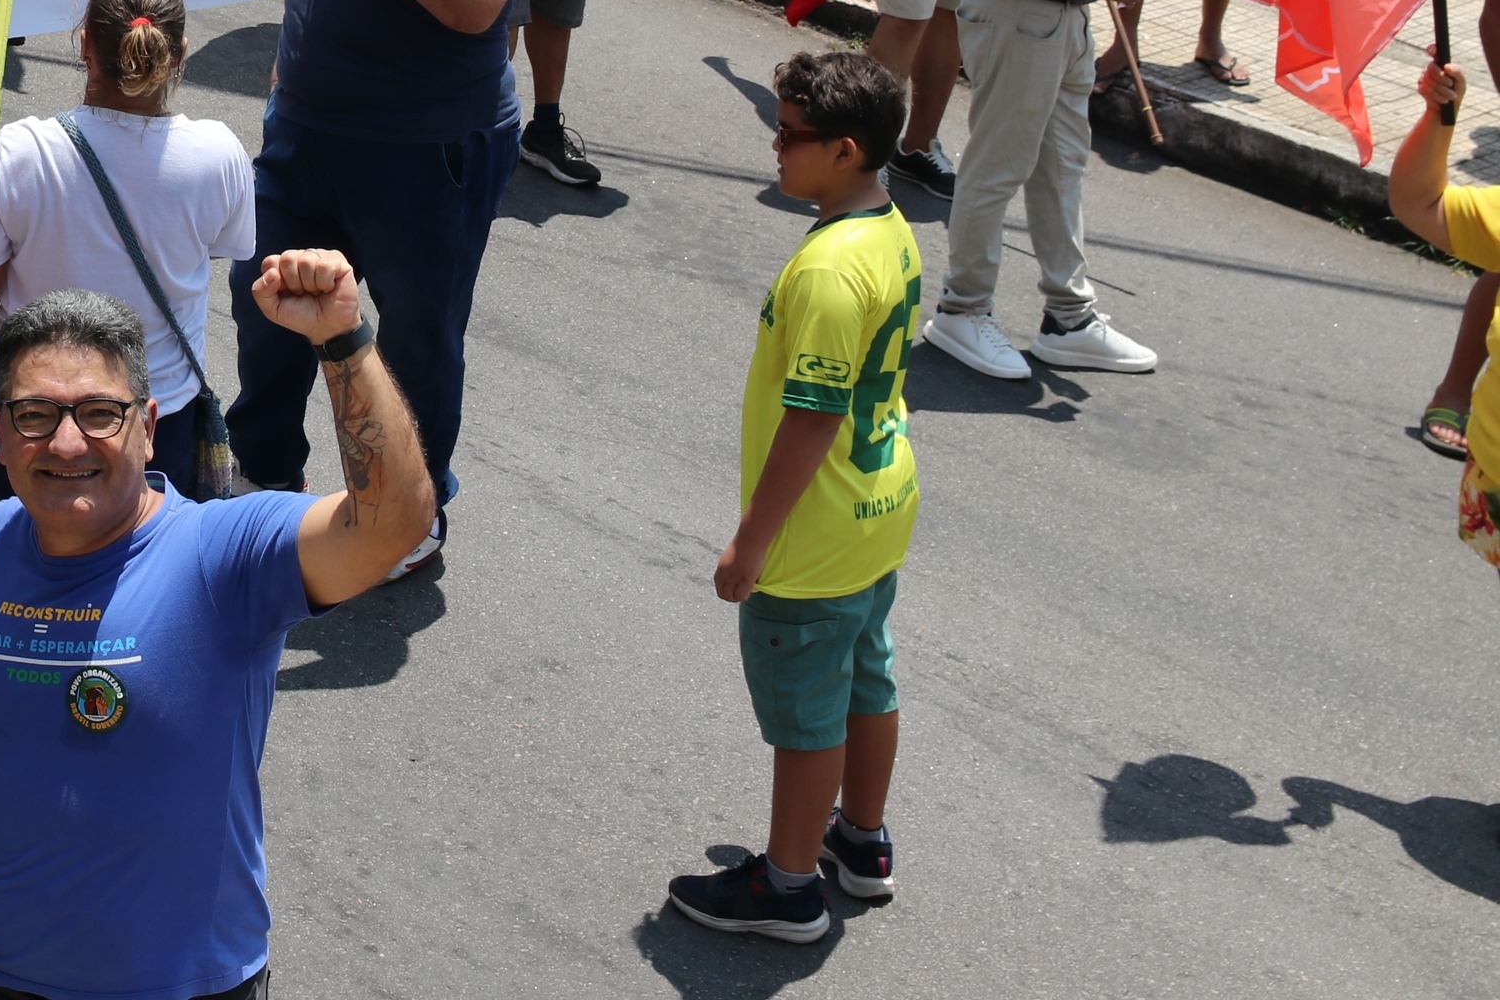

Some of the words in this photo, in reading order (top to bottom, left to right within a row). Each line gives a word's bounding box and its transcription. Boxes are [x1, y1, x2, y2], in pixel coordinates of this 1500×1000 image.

[0, 601, 102, 622] RECONSTRUIR
[29, 635, 137, 656] ESPERANÇAR
[70, 675, 83, 696] POVO
[82, 669, 124, 699] ORGANIZADO
[70, 702, 90, 728] BRASIL
[90, 705, 124, 730] SOBERANO
